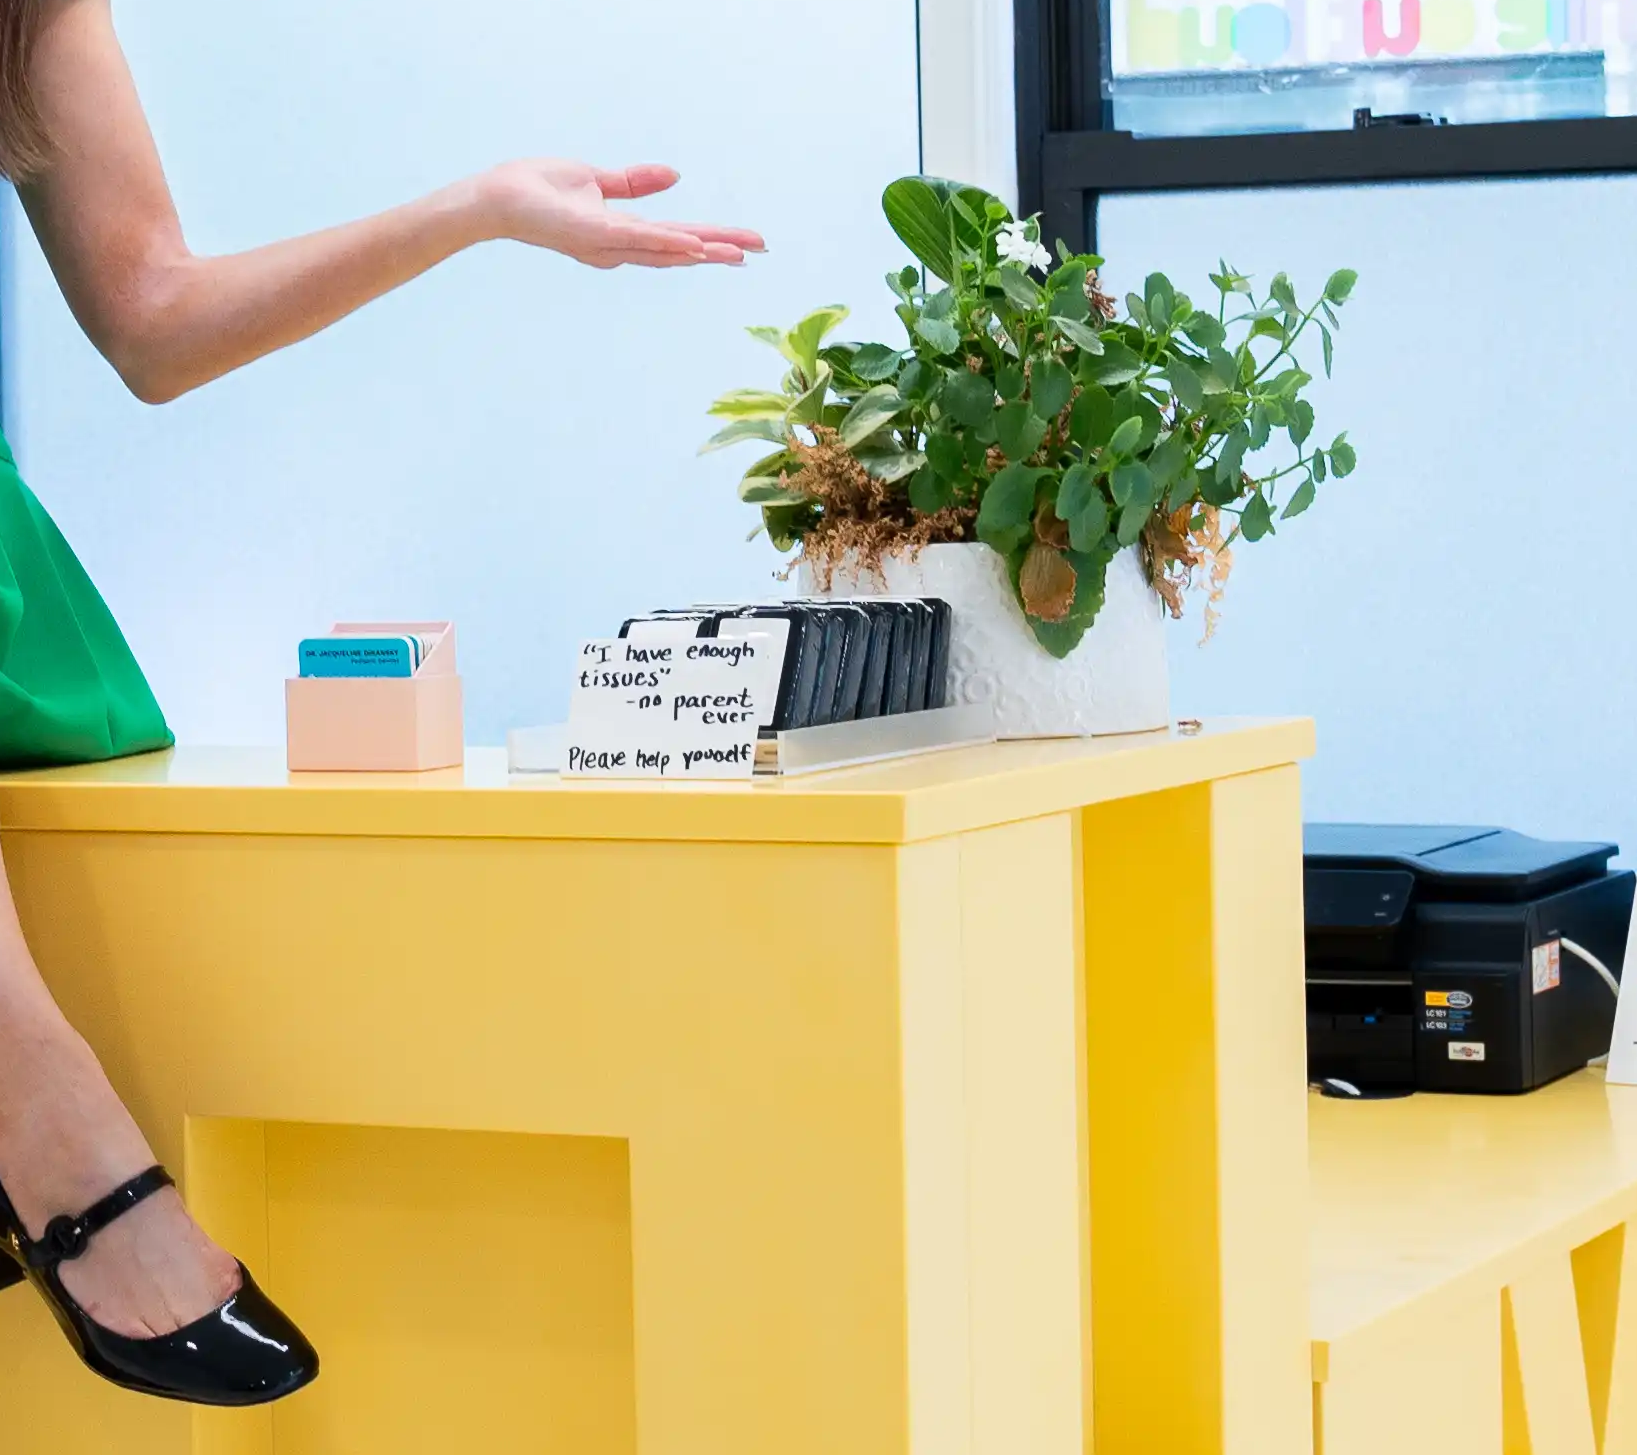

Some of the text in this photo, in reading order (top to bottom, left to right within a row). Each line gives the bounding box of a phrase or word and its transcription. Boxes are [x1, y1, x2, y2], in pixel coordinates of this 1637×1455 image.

[626, 645, 672, 663] have
[686, 642, 755, 666] enough
[674, 688, 754, 721] parent
[702, 710, 754, 725] ever
[569, 746, 626, 770] Please
[636, 749, 670, 775] help
